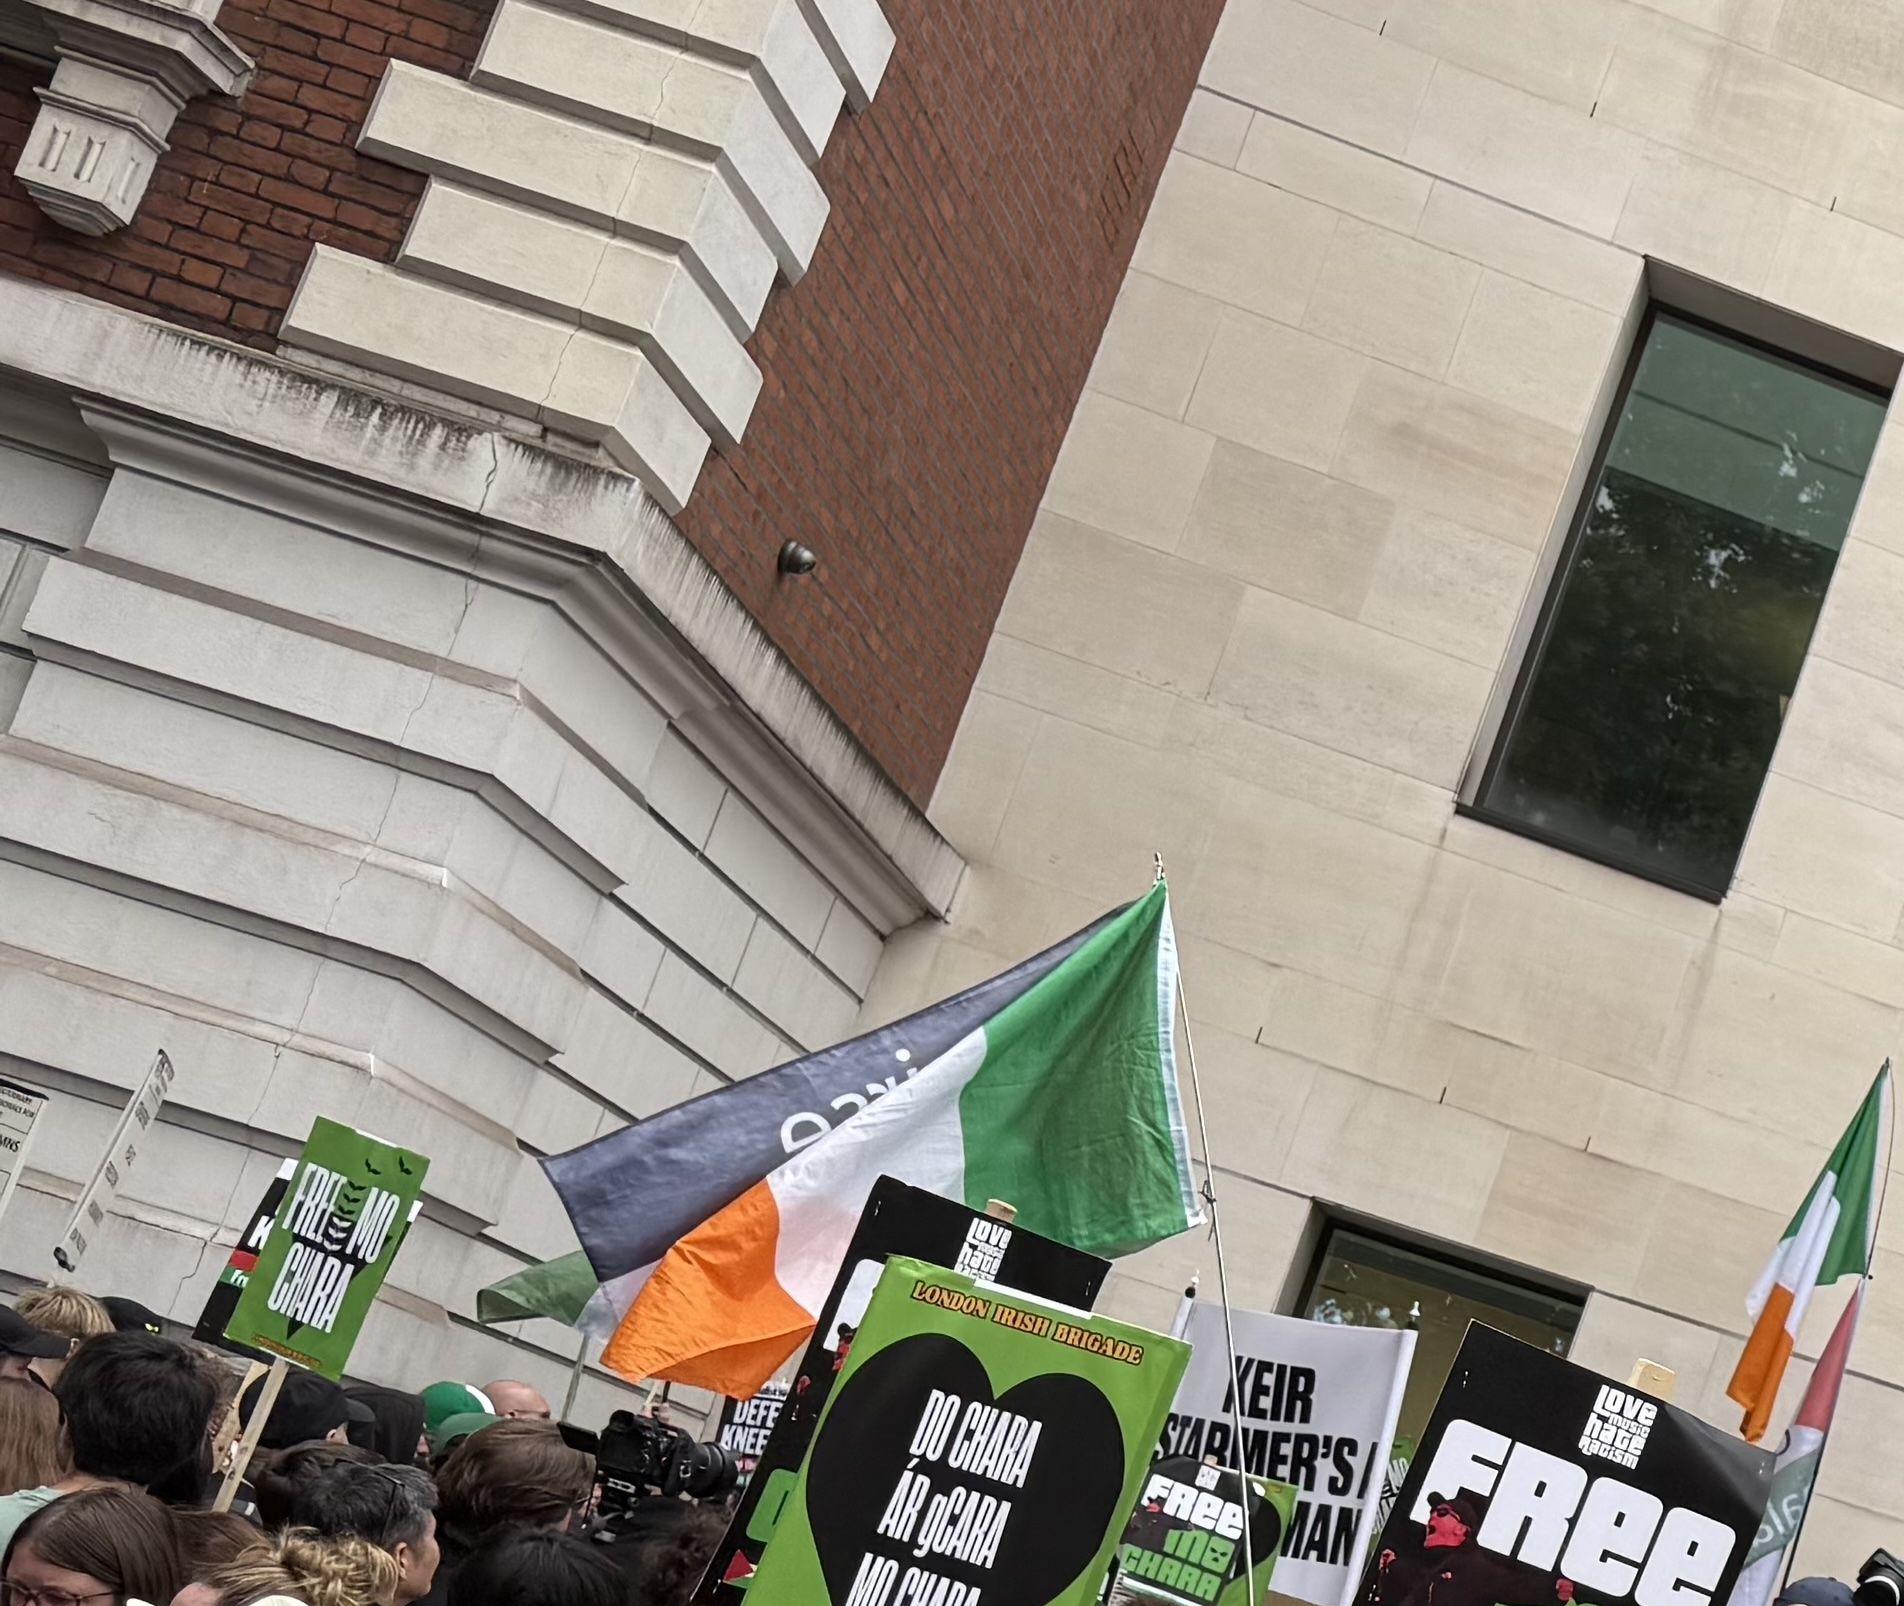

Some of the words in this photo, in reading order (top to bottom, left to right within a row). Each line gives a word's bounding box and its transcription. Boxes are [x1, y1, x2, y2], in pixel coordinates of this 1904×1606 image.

[281, 1162, 348, 1244] FREE
[345, 1186, 400, 1264] MO
[267, 1241, 355, 1333] CHARA
[912, 1281, 990, 1319] LONDON
[992, 1300, 1051, 1337] IRISH
[1051, 1322, 1144, 1366] BRIGADE
[1222, 1355, 1316, 1425] KEIR
[1593, 1384, 1658, 1427] Love
[909, 1389, 961, 1462] DO
[948, 1401, 1043, 1488] CHARA
[1583, 1412, 1646, 1456] hate
[876, 1458, 931, 1542] ÁR
[912, 1485, 1012, 1569] gCARA
[1119, 1543, 1222, 1602] CHARA
